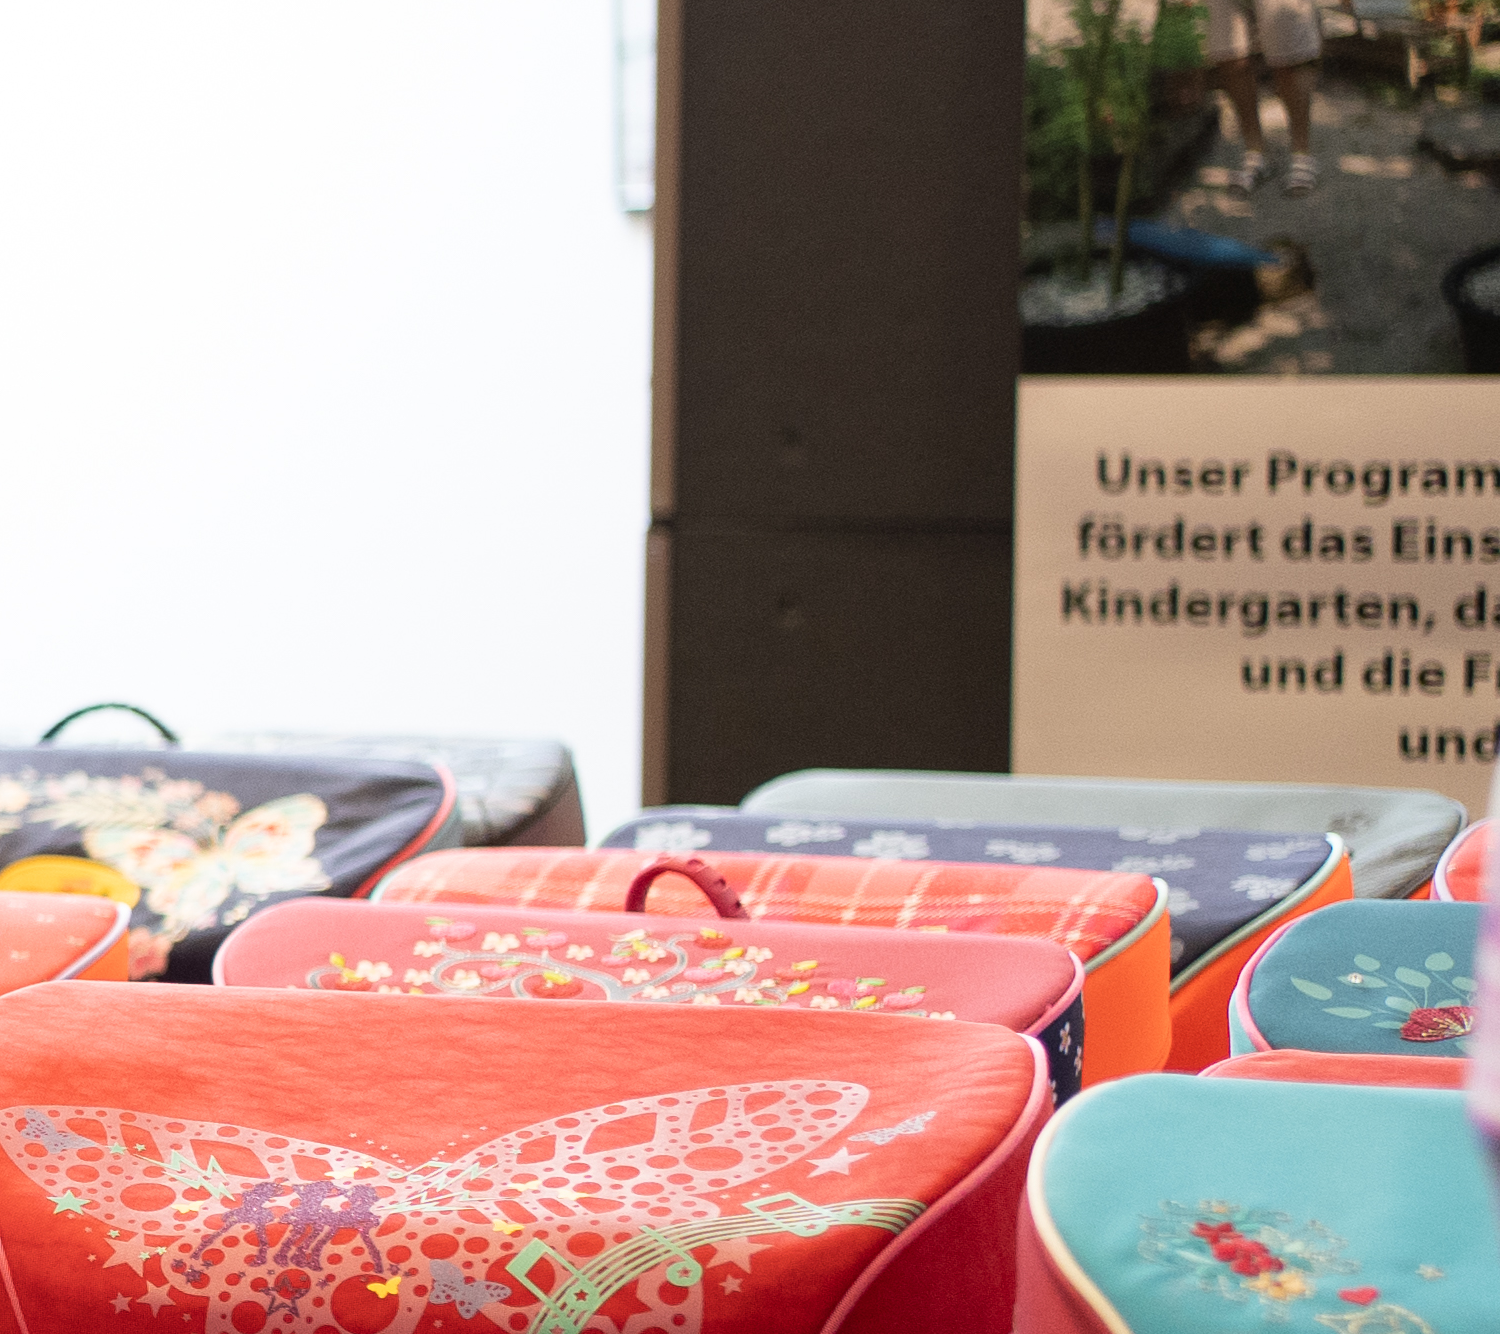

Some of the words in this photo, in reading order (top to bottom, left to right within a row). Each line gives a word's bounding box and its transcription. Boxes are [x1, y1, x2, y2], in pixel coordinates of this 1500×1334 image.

[1096, 450, 1250, 496] Unser
[1266, 448, 1500, 507] Program
[1078, 513, 1265, 562] fördert
[1281, 515, 1375, 562] das
[1391, 516, 1500, 564] Eins
[1061, 578, 1435, 637] Kindergarten,
[1241, 648, 1343, 694] und
[1362, 647, 1445, 695] die
